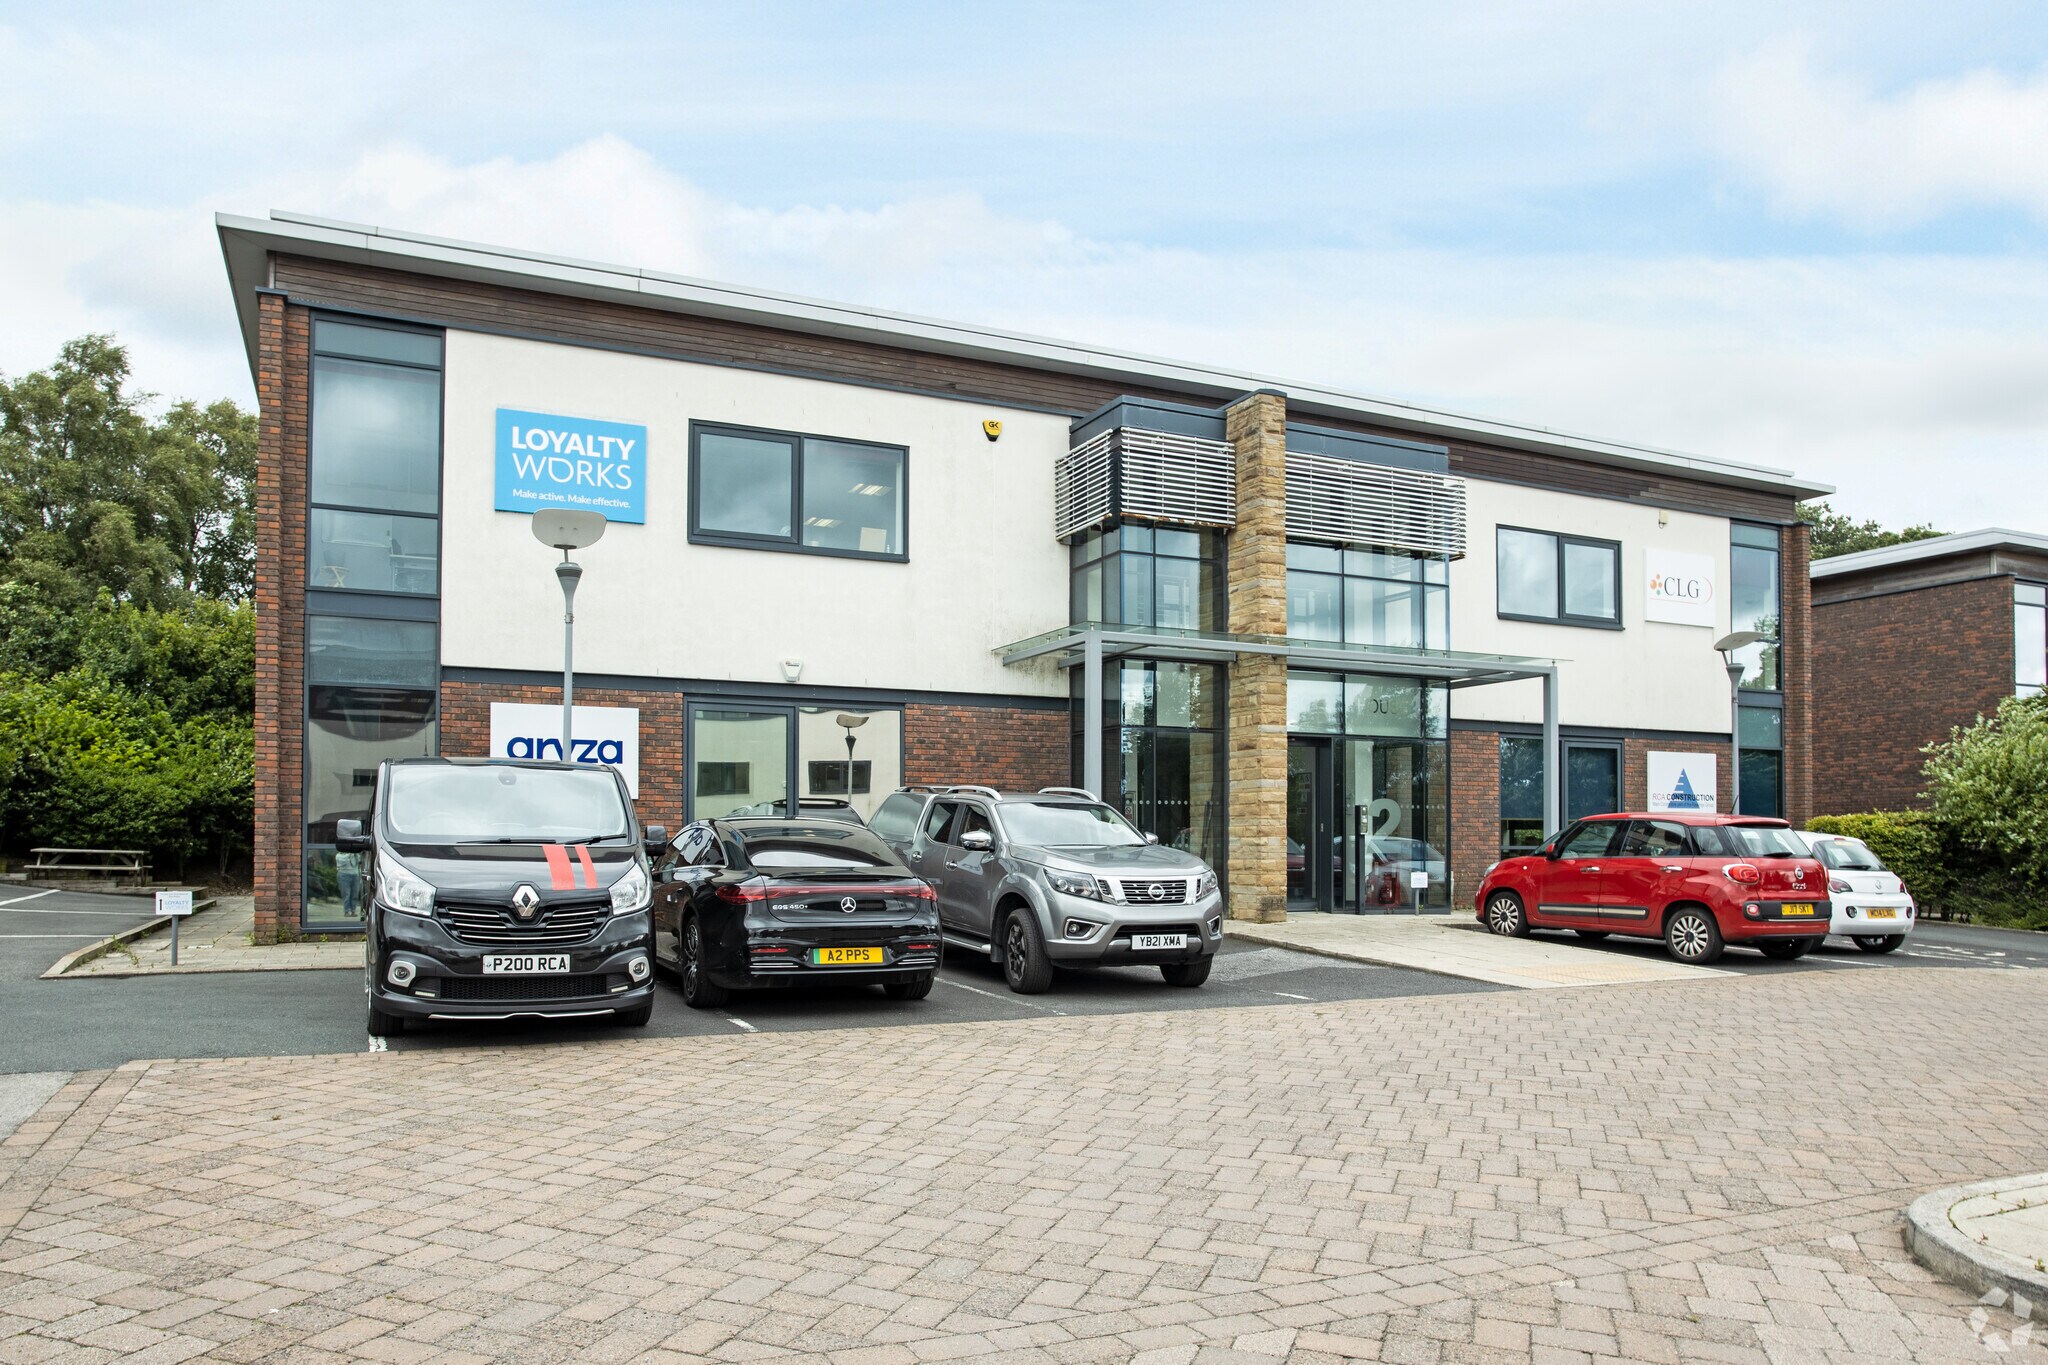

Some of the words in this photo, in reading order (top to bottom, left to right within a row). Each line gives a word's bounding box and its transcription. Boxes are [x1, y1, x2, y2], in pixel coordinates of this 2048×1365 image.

[511, 425, 636, 461] LOYALTY
[511, 452, 632, 490] WORKS
[512, 488, 538, 499] Make
[538, 492, 566, 502] active.
[567, 494, 592, 505] Make
[592, 496, 631, 509] effective.
[1663, 576, 1700, 599] CLG
[1666, 793, 1715, 802] CONSTRUCTION
[1367, 798, 1402, 853] 2
[1140, 936, 1161, 947] YB21
[1163, 935, 1181, 946] XMA
[493, 957, 533, 971] P200
[538, 957, 567, 971] RCA
[828, 949, 843, 962] A2
[846, 949, 870, 961] PPS
